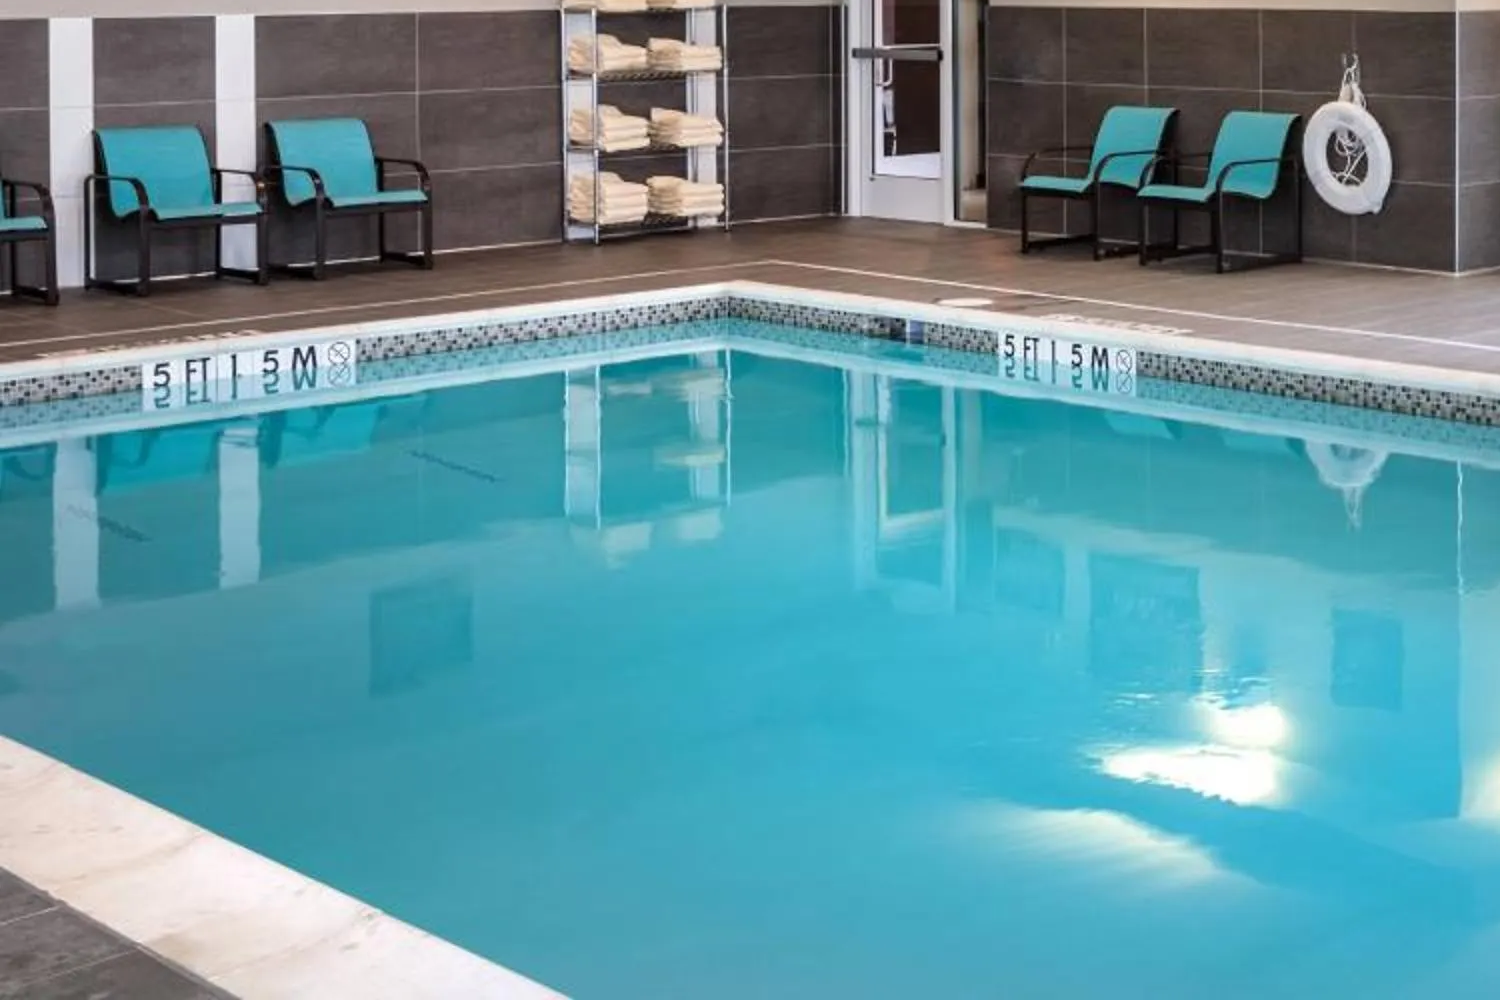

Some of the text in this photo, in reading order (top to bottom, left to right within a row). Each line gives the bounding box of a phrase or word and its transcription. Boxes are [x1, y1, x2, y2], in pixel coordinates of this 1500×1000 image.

[153, 362, 171, 388] 5
[185, 357, 211, 382] FT
[292, 345, 318, 370] M
[1004, 334, 1016, 358] 5
[1023, 336, 1040, 361] FT
[1091, 345, 1109, 369] M
